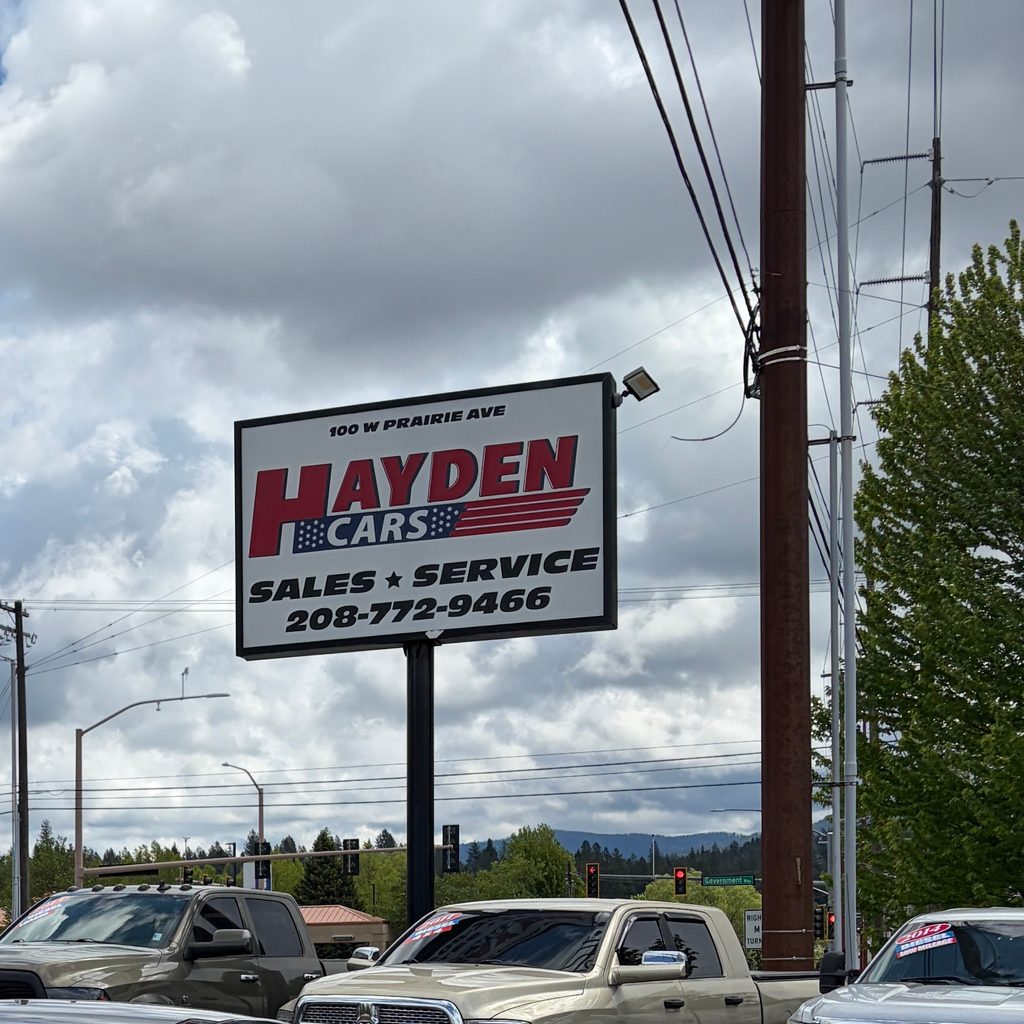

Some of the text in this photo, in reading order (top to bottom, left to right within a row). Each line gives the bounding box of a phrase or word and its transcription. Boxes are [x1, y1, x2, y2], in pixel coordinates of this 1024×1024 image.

[329, 405, 506, 437] 100 W PRAIRIE AVE
[249, 435, 578, 558] HAYDEN
[326, 509, 430, 547] CARS
[248, 547, 600, 603] SALES SERVICE
[285, 586, 552, 632] 208-772-9466
[705, 877, 743, 885] Government
[747, 914, 762, 922] RIGH
